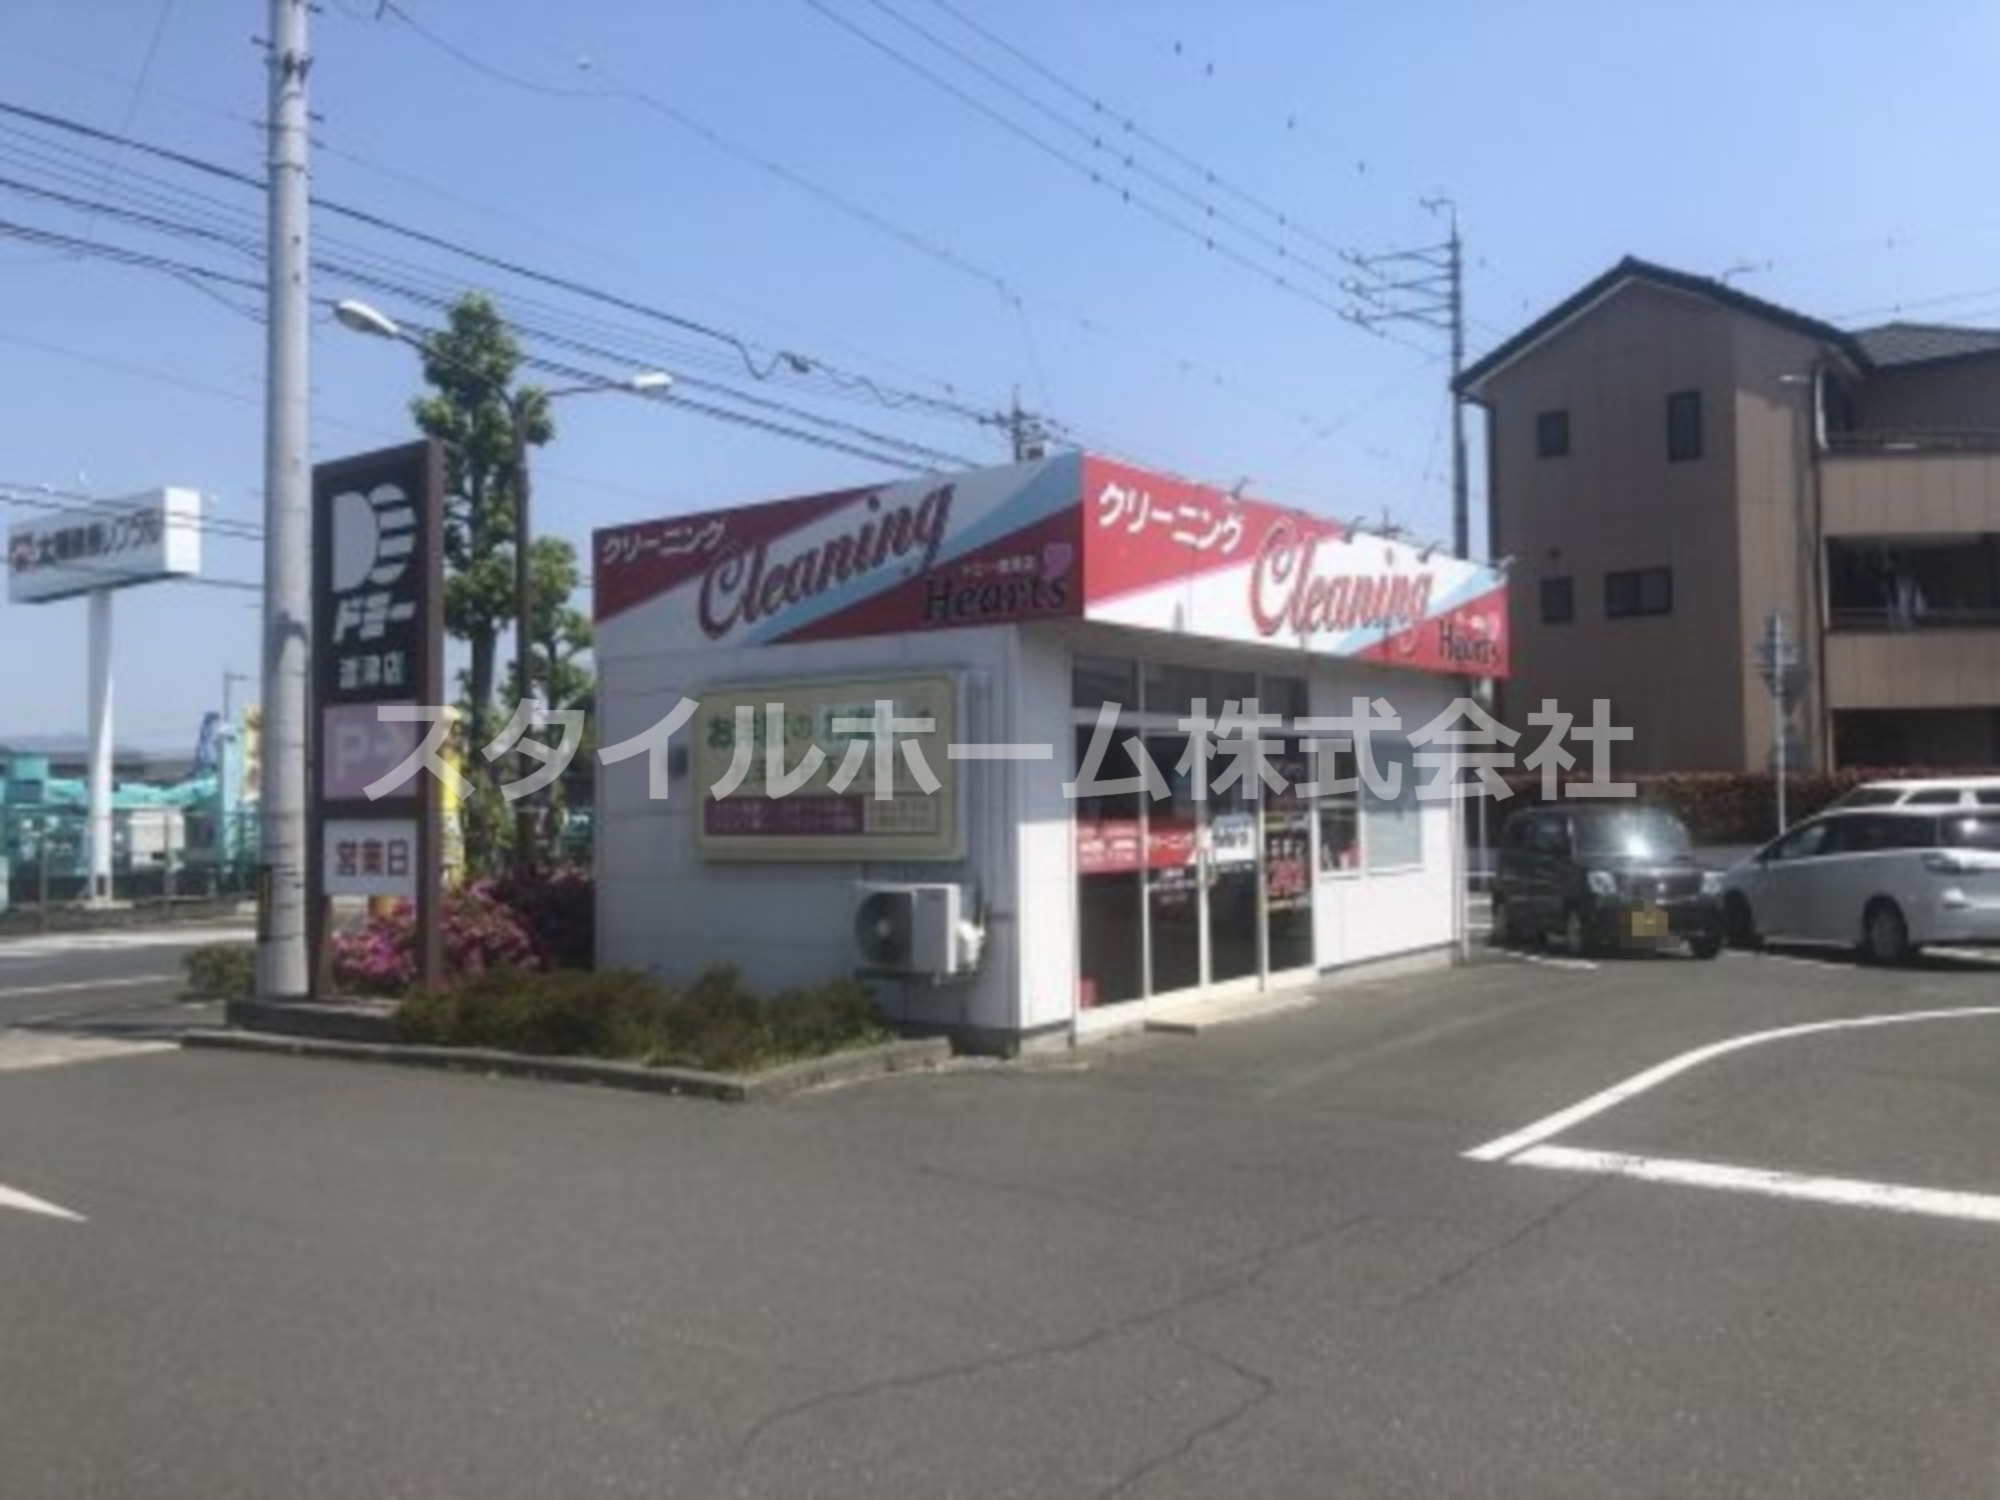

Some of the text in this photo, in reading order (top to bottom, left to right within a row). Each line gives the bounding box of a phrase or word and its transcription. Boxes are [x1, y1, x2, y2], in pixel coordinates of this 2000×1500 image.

[601, 519, 726, 565] クリーニング
[1098, 482, 1246, 554] クリーニング
[699, 484, 957, 640] Cleaning
[1249, 516, 1436, 658] Cleaning
[333, 592, 417, 643] ドミー
[922, 574, 1068, 622] Hearts
